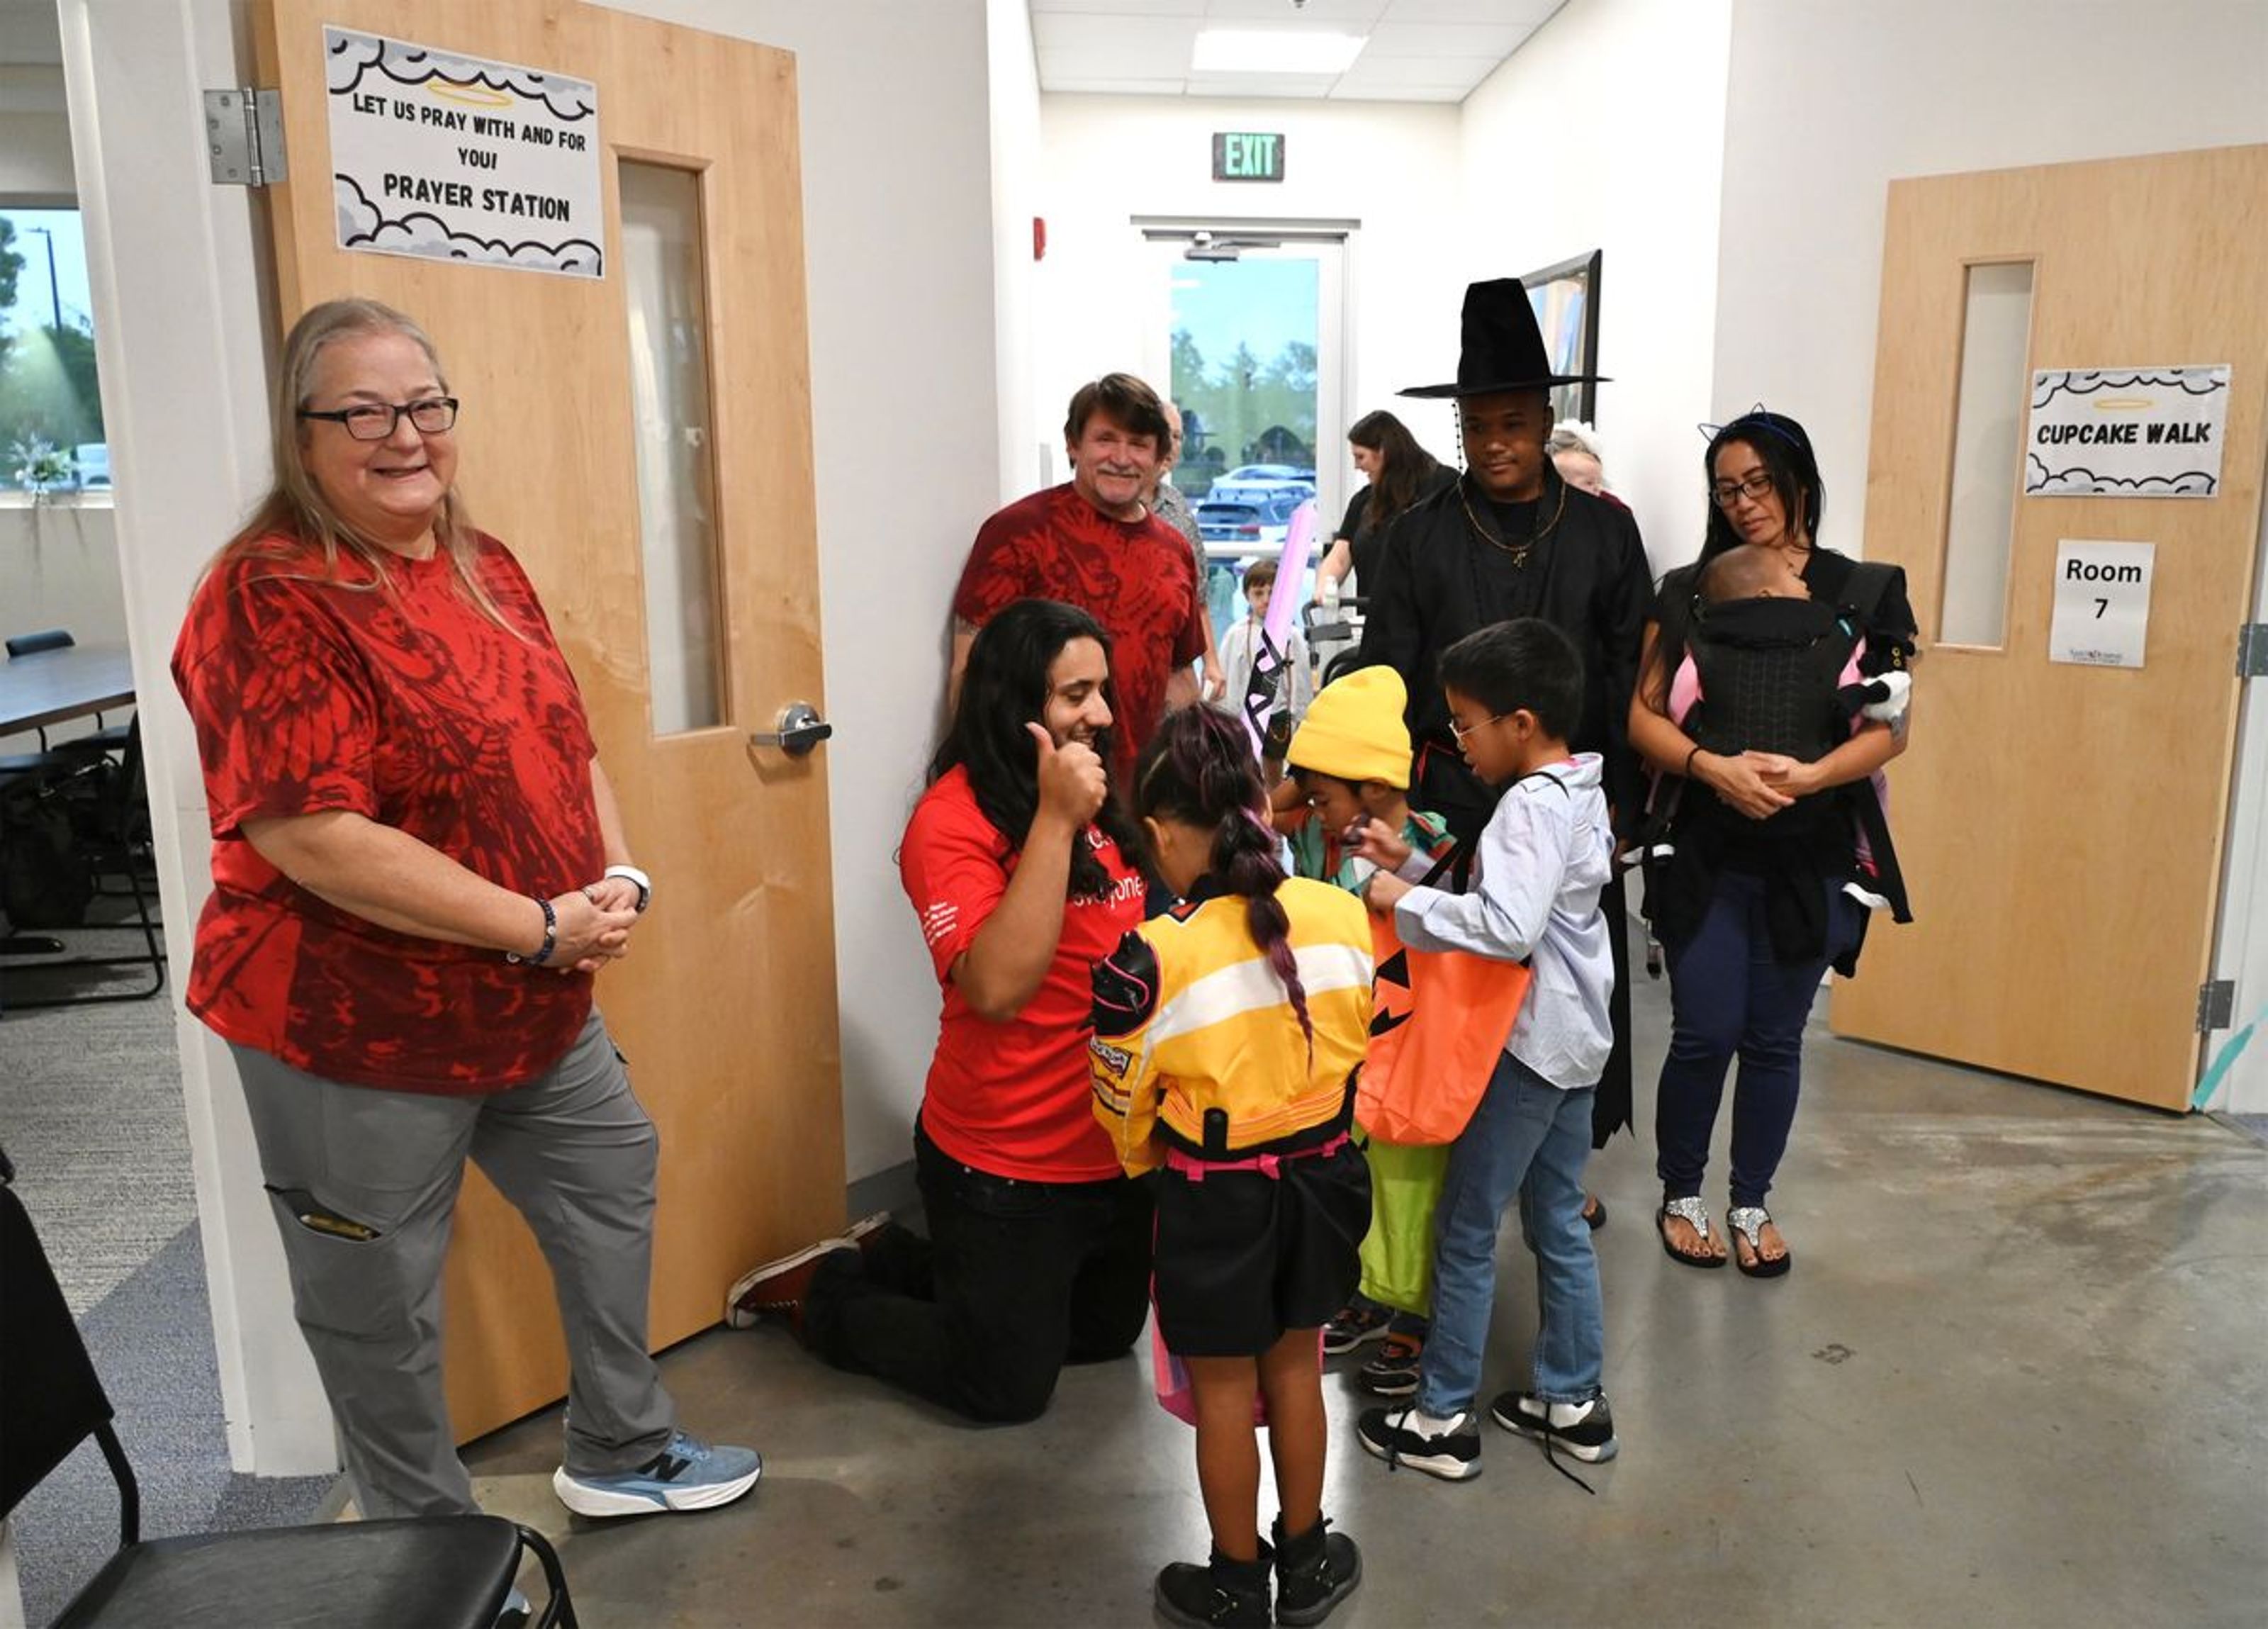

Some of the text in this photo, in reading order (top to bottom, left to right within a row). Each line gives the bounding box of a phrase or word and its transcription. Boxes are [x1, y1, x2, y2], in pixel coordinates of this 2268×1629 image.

[353, 92, 585, 152] LET US PRAY WITH AND FOR
[1225, 135, 1276, 176] EXIT
[383, 173, 570, 222] PRAYER STATION
[2037, 422, 2211, 444] CUPCAKE WALK
[2067, 559, 2142, 583] Room
[2094, 598, 2109, 619] 7
